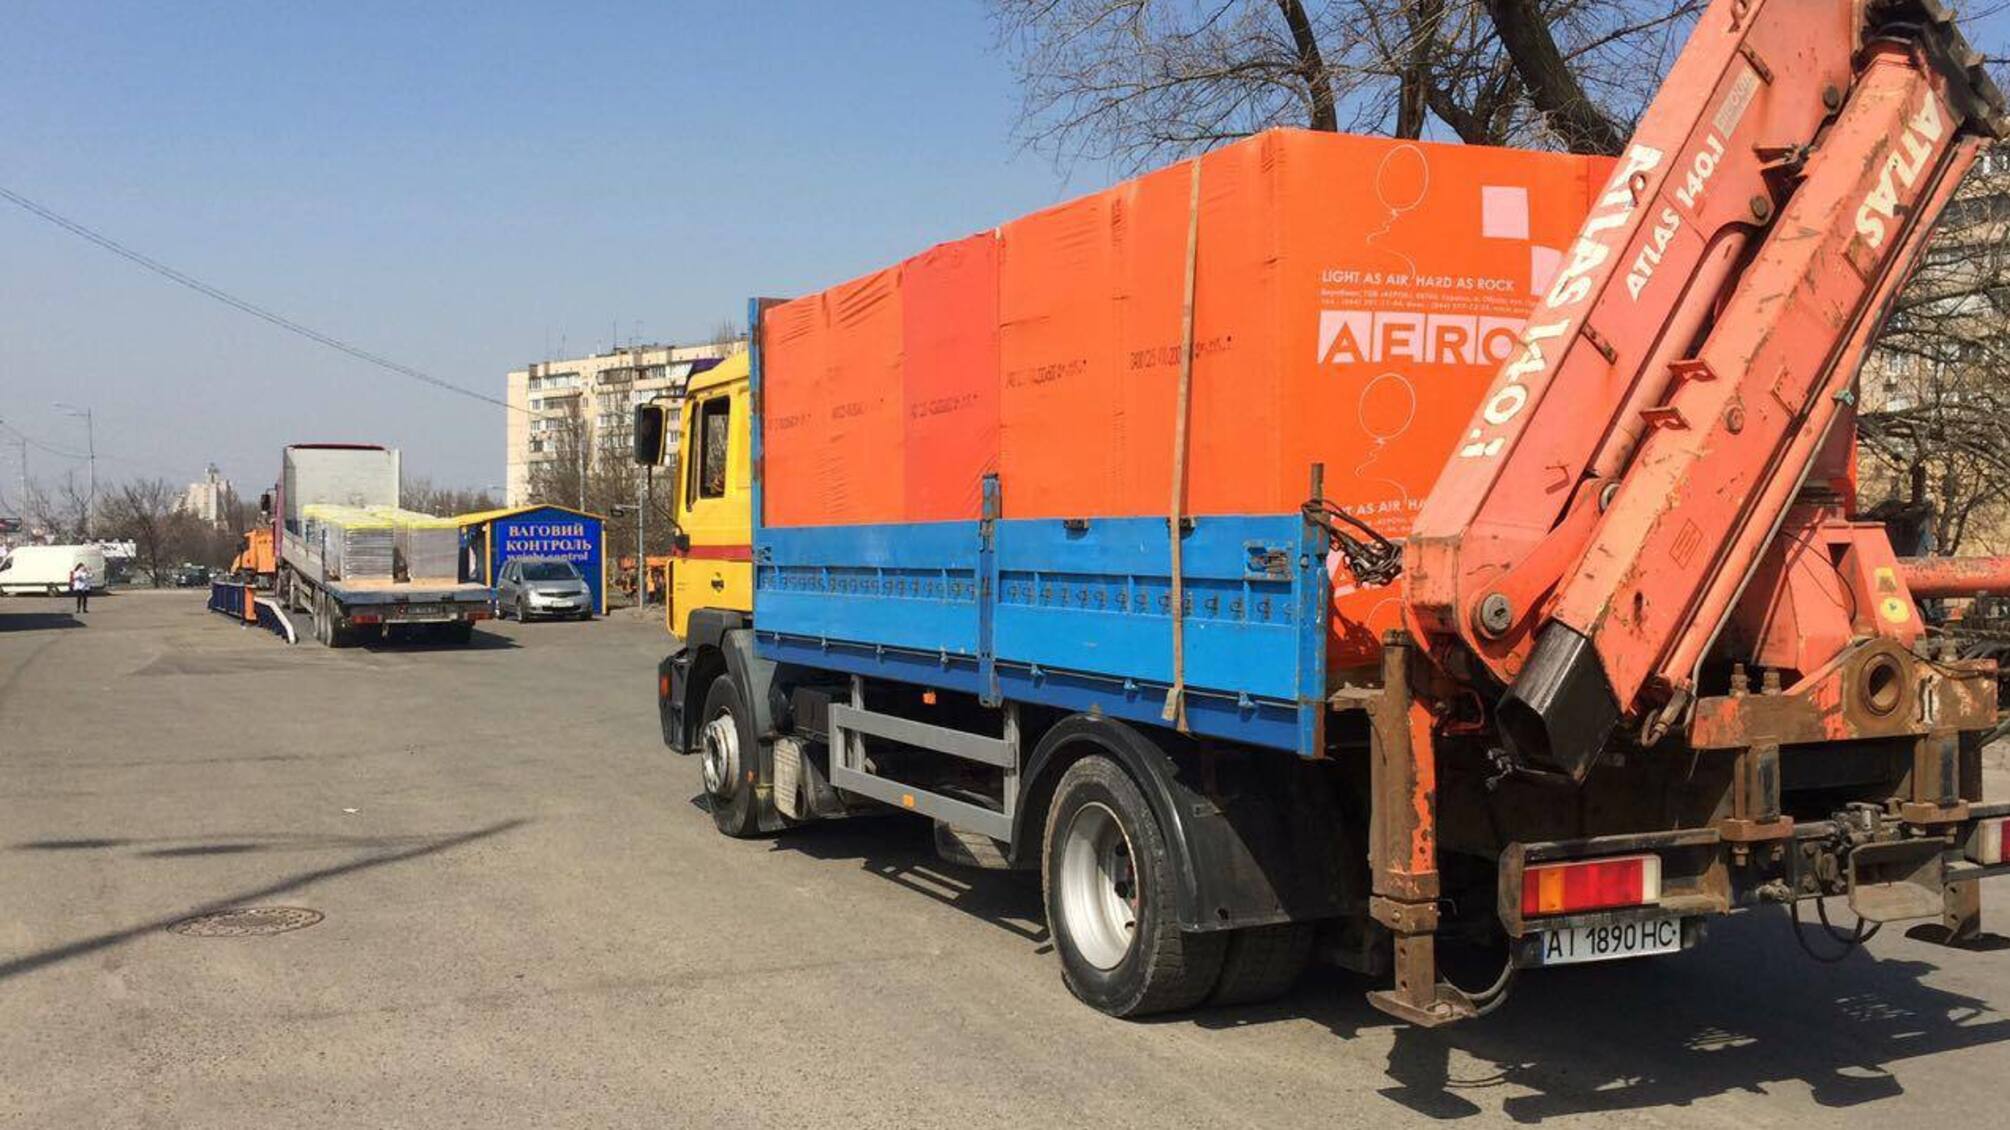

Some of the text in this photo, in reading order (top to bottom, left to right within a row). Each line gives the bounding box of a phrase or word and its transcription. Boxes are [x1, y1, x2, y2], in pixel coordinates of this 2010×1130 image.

[1855, 88, 1943, 249] ATLAS
[1546, 144, 1664, 309] ATLAS
[1626, 207, 1680, 302] ATLAS
[1322, 270, 1516, 291] LIGHT AS AIR HARD AS ROCK
[1357, 503, 1375, 515] AS
[1378, 500, 1401, 513] AIR
[509, 522, 584, 537] ВАГОВИЙ
[506, 539, 592, 551] КОНТРОЛЬ
[1547, 920, 1673, 958] AI 1890 HC
